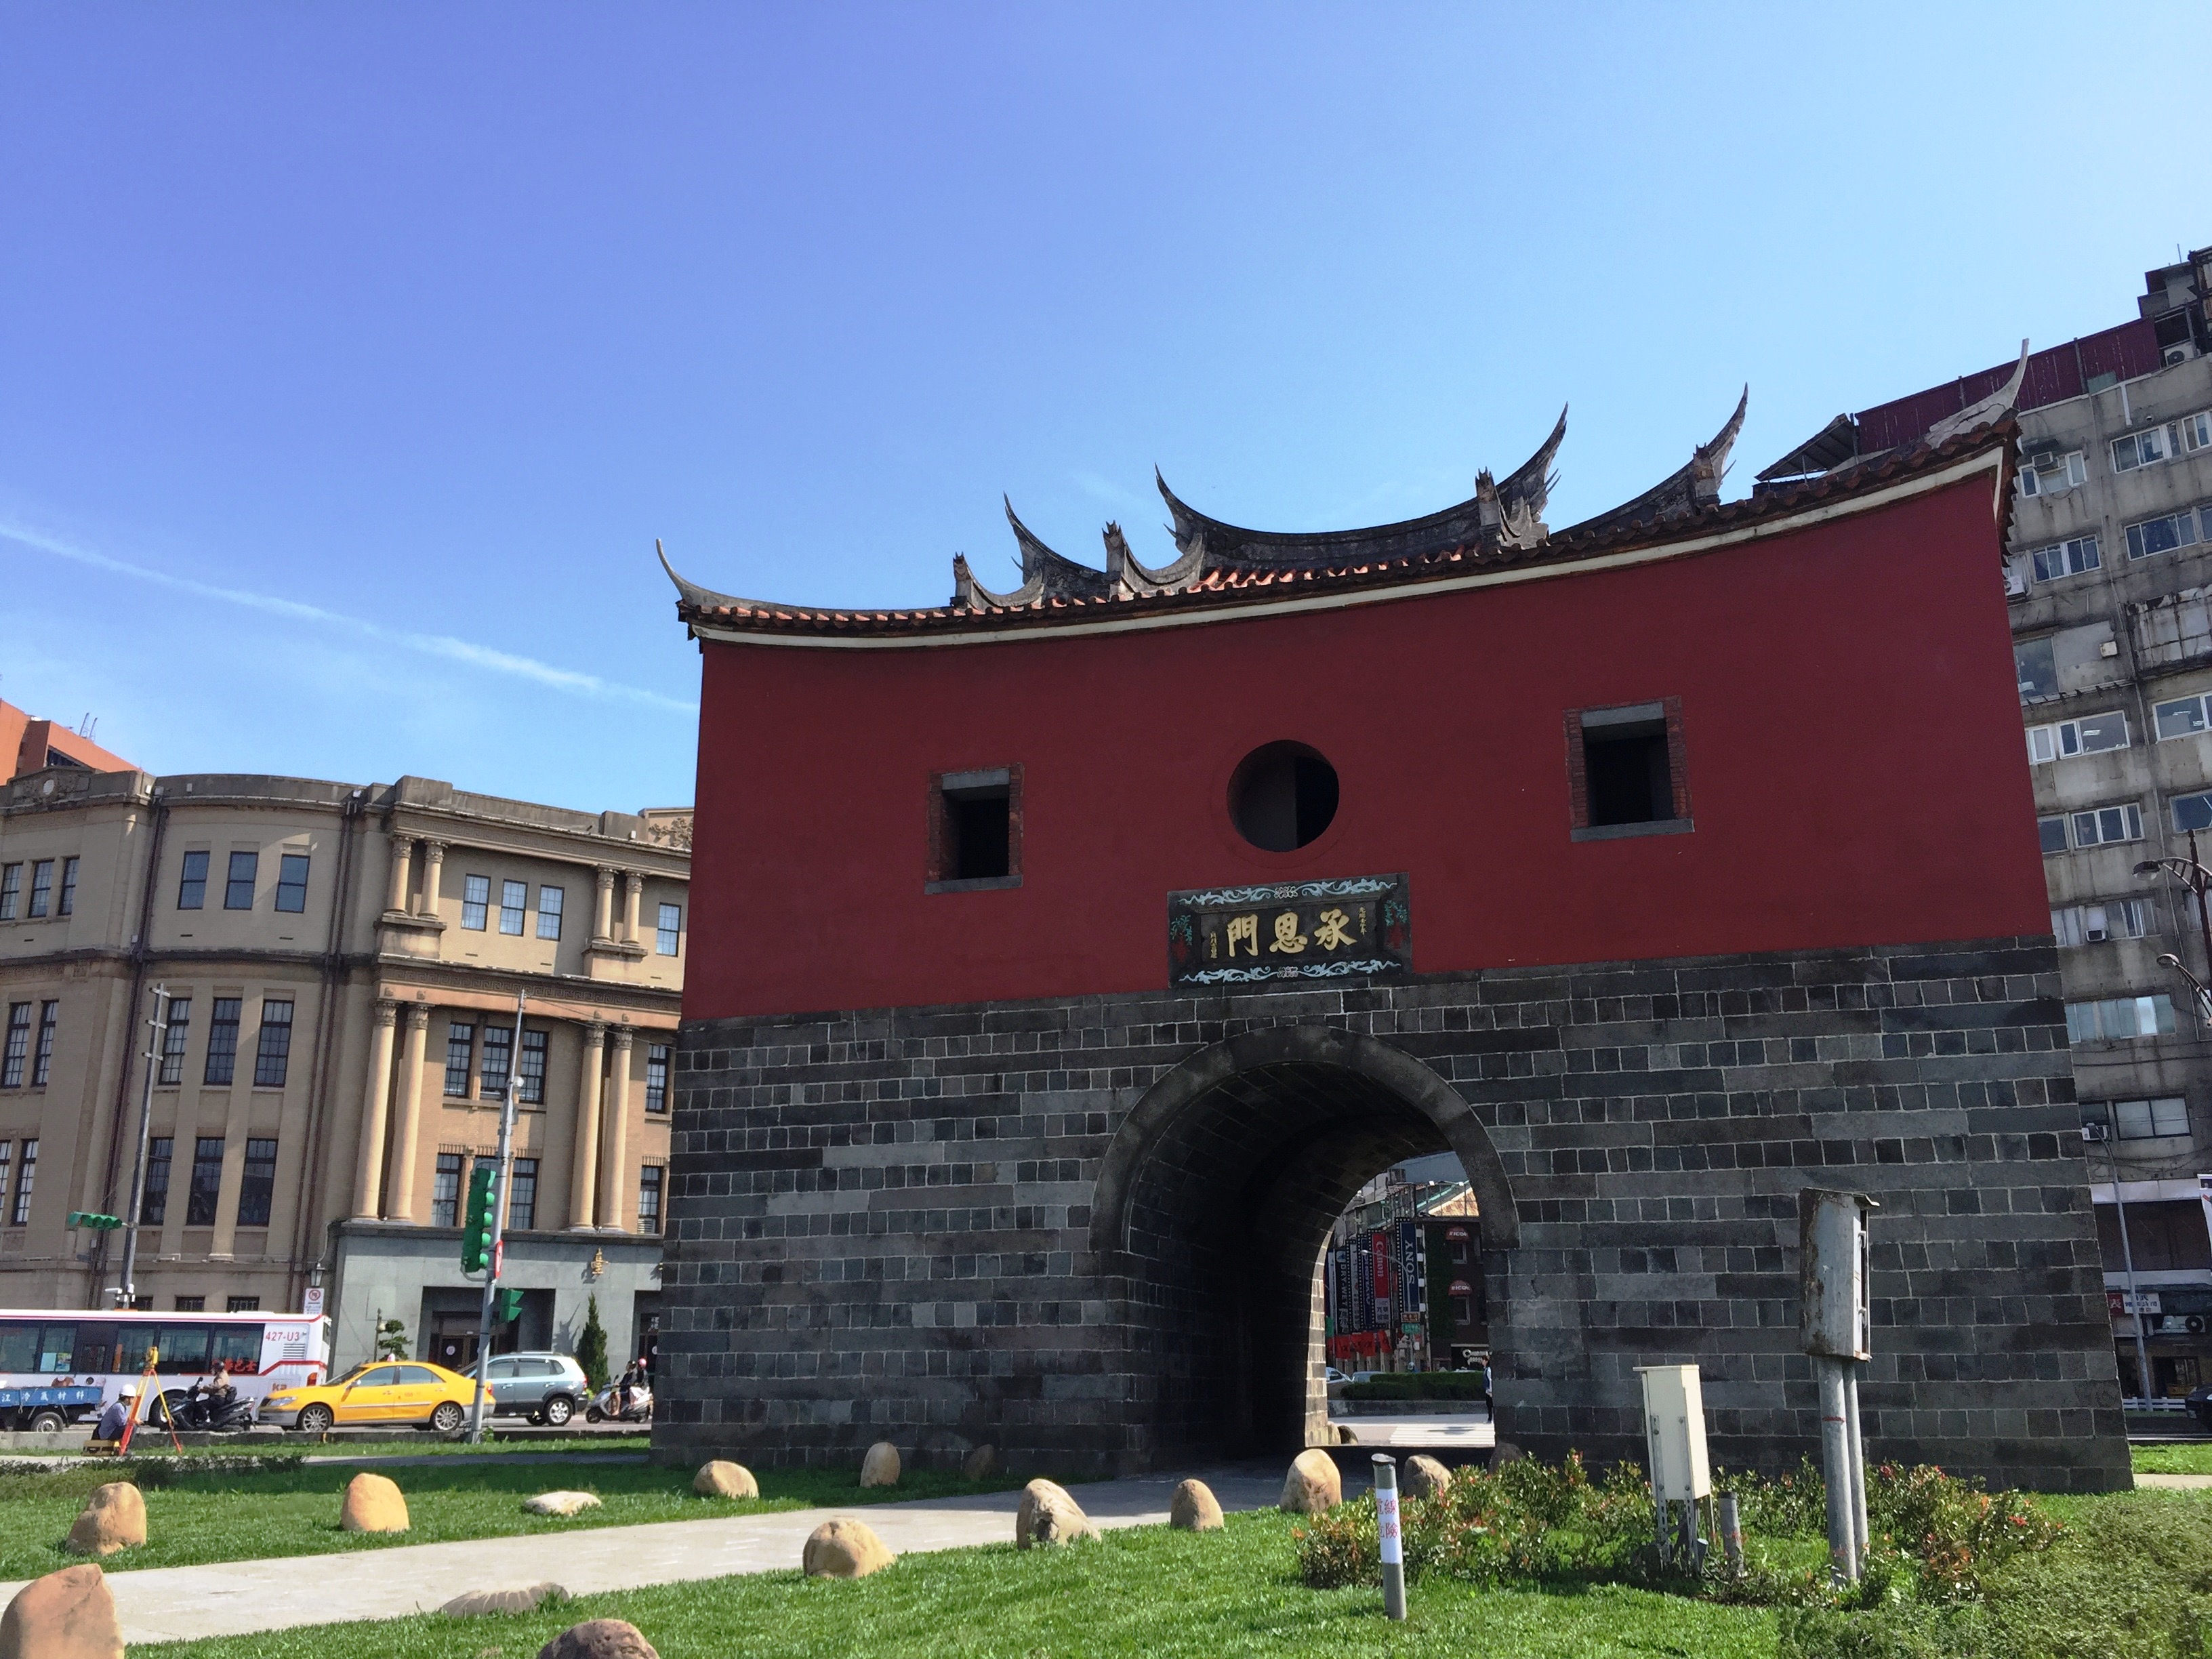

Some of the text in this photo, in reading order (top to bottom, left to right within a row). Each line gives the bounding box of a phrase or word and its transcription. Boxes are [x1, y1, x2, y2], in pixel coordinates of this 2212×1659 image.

[1227, 908, 1357, 958] 承恩門
[1376, 1241, 1384, 1277] Canon
[1405, 1240, 1415, 1284] SONY
[1340, 1264, 1349, 1307] DRY-WET
[265, 1332, 300, 1341] 427-U3
